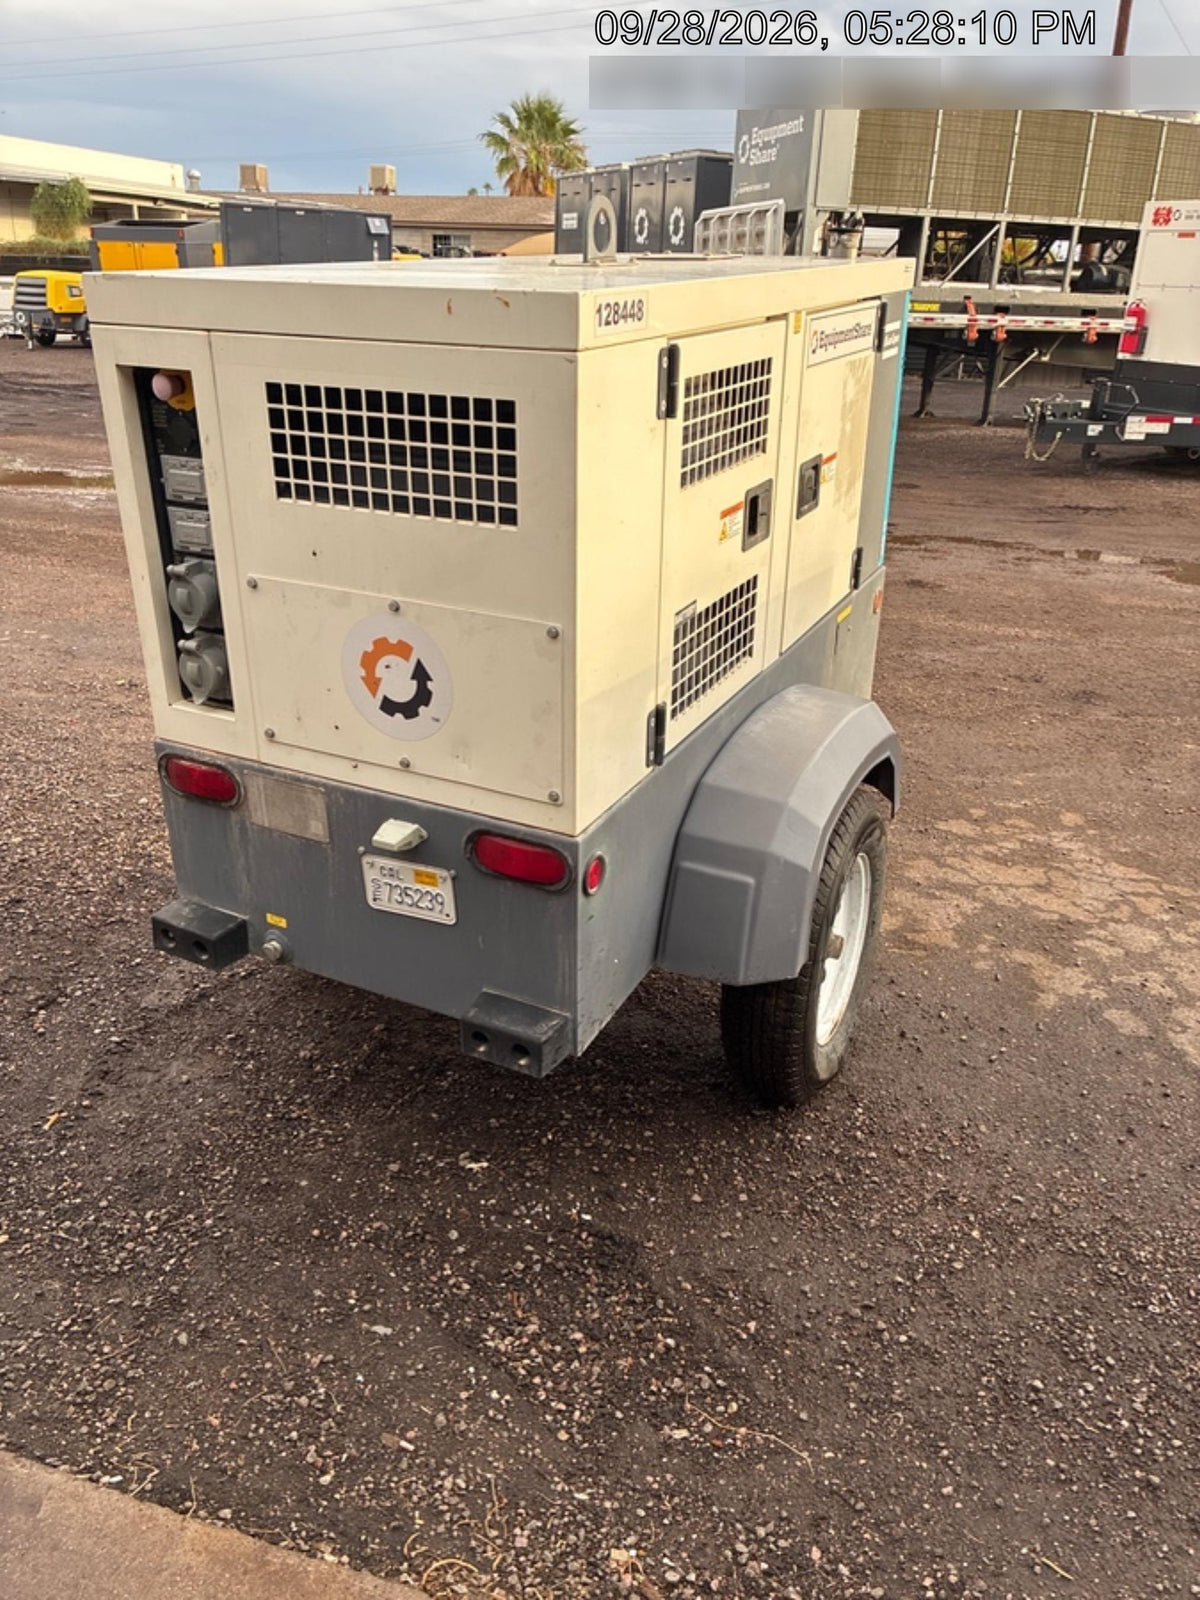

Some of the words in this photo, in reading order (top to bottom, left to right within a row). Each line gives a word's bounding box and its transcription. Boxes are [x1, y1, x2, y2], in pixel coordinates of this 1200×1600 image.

[751, 115, 804, 147] Equipment
[749, 147, 778, 166] Share
[595, 298, 644, 328] 128448
[820, 322, 872, 352] EquipmentShare
[380, 865, 404, 881] CAL
[383, 880, 446, 914] 735239
